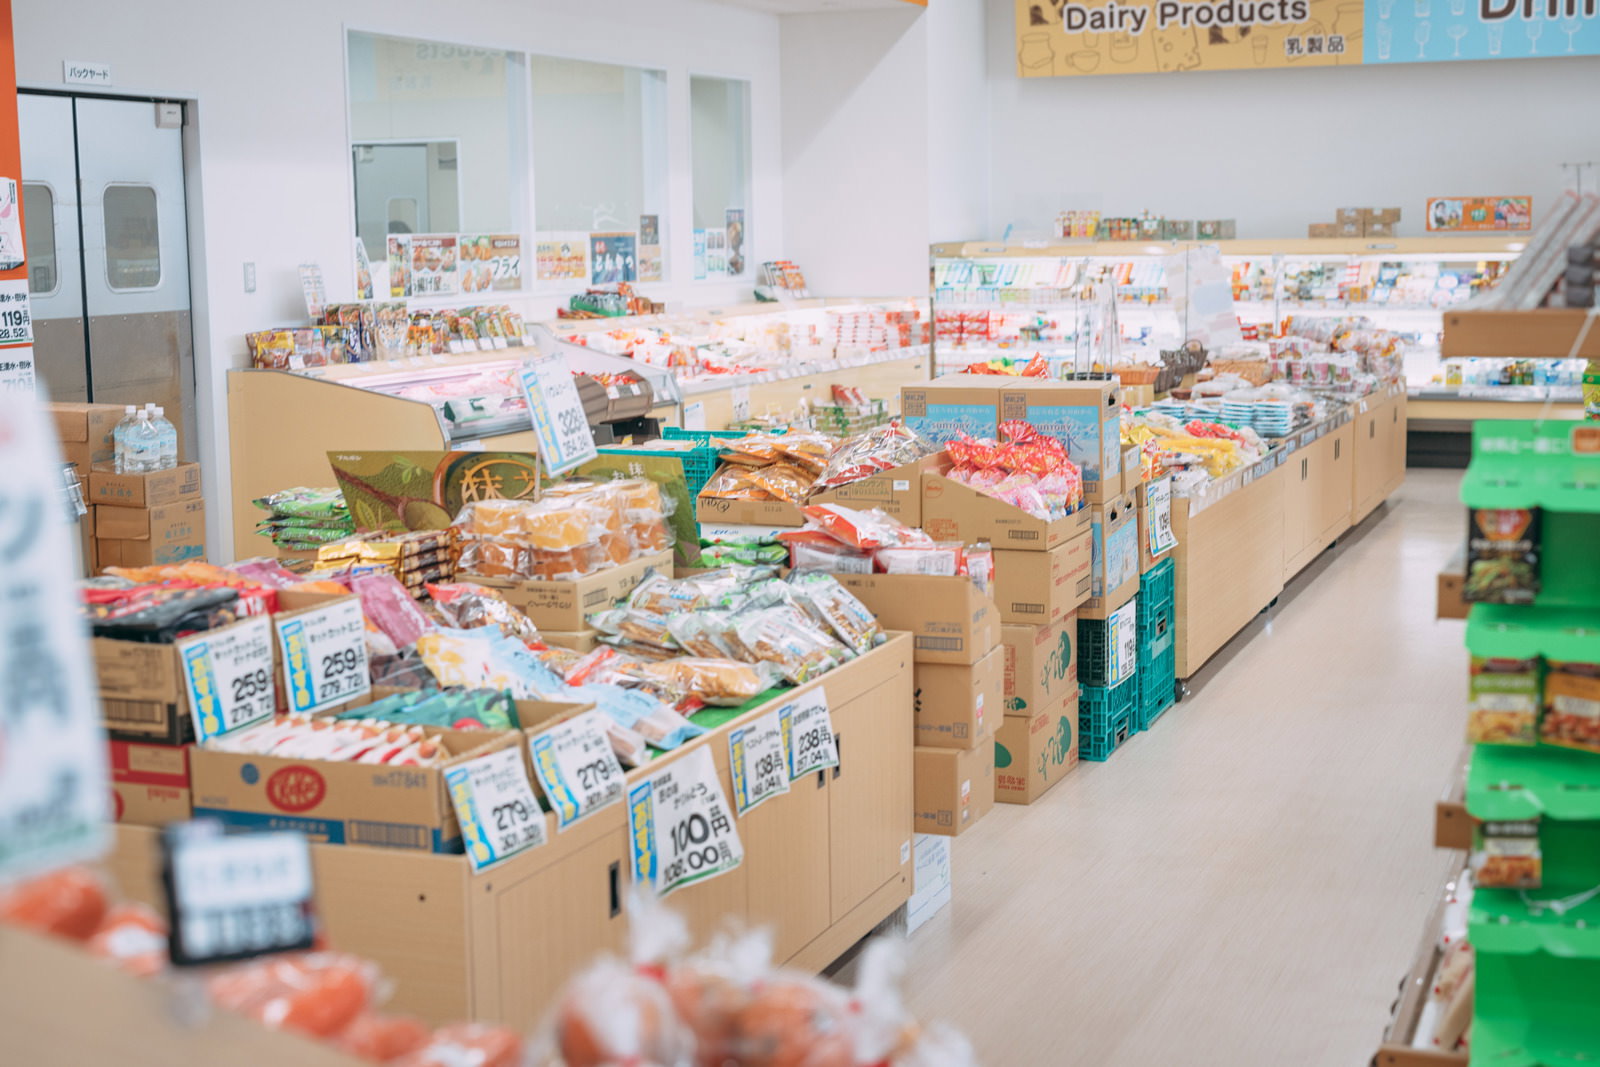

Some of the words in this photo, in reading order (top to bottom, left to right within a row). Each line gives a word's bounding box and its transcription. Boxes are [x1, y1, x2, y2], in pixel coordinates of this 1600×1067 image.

[1066, 5, 1147, 32] Dairy
[1159, 0, 1308, 27] Products
[1286, 36, 1345, 54] 乳製品
[70, 67, 109, 80] バックヤード
[322, 648, 357, 680] 259
[232, 668, 267, 703] 259
[577, 757, 610, 791] 279
[492, 799, 529, 832] 279
[671, 813, 731, 858] 100円
[664, 845, 719, 885] 108.00
